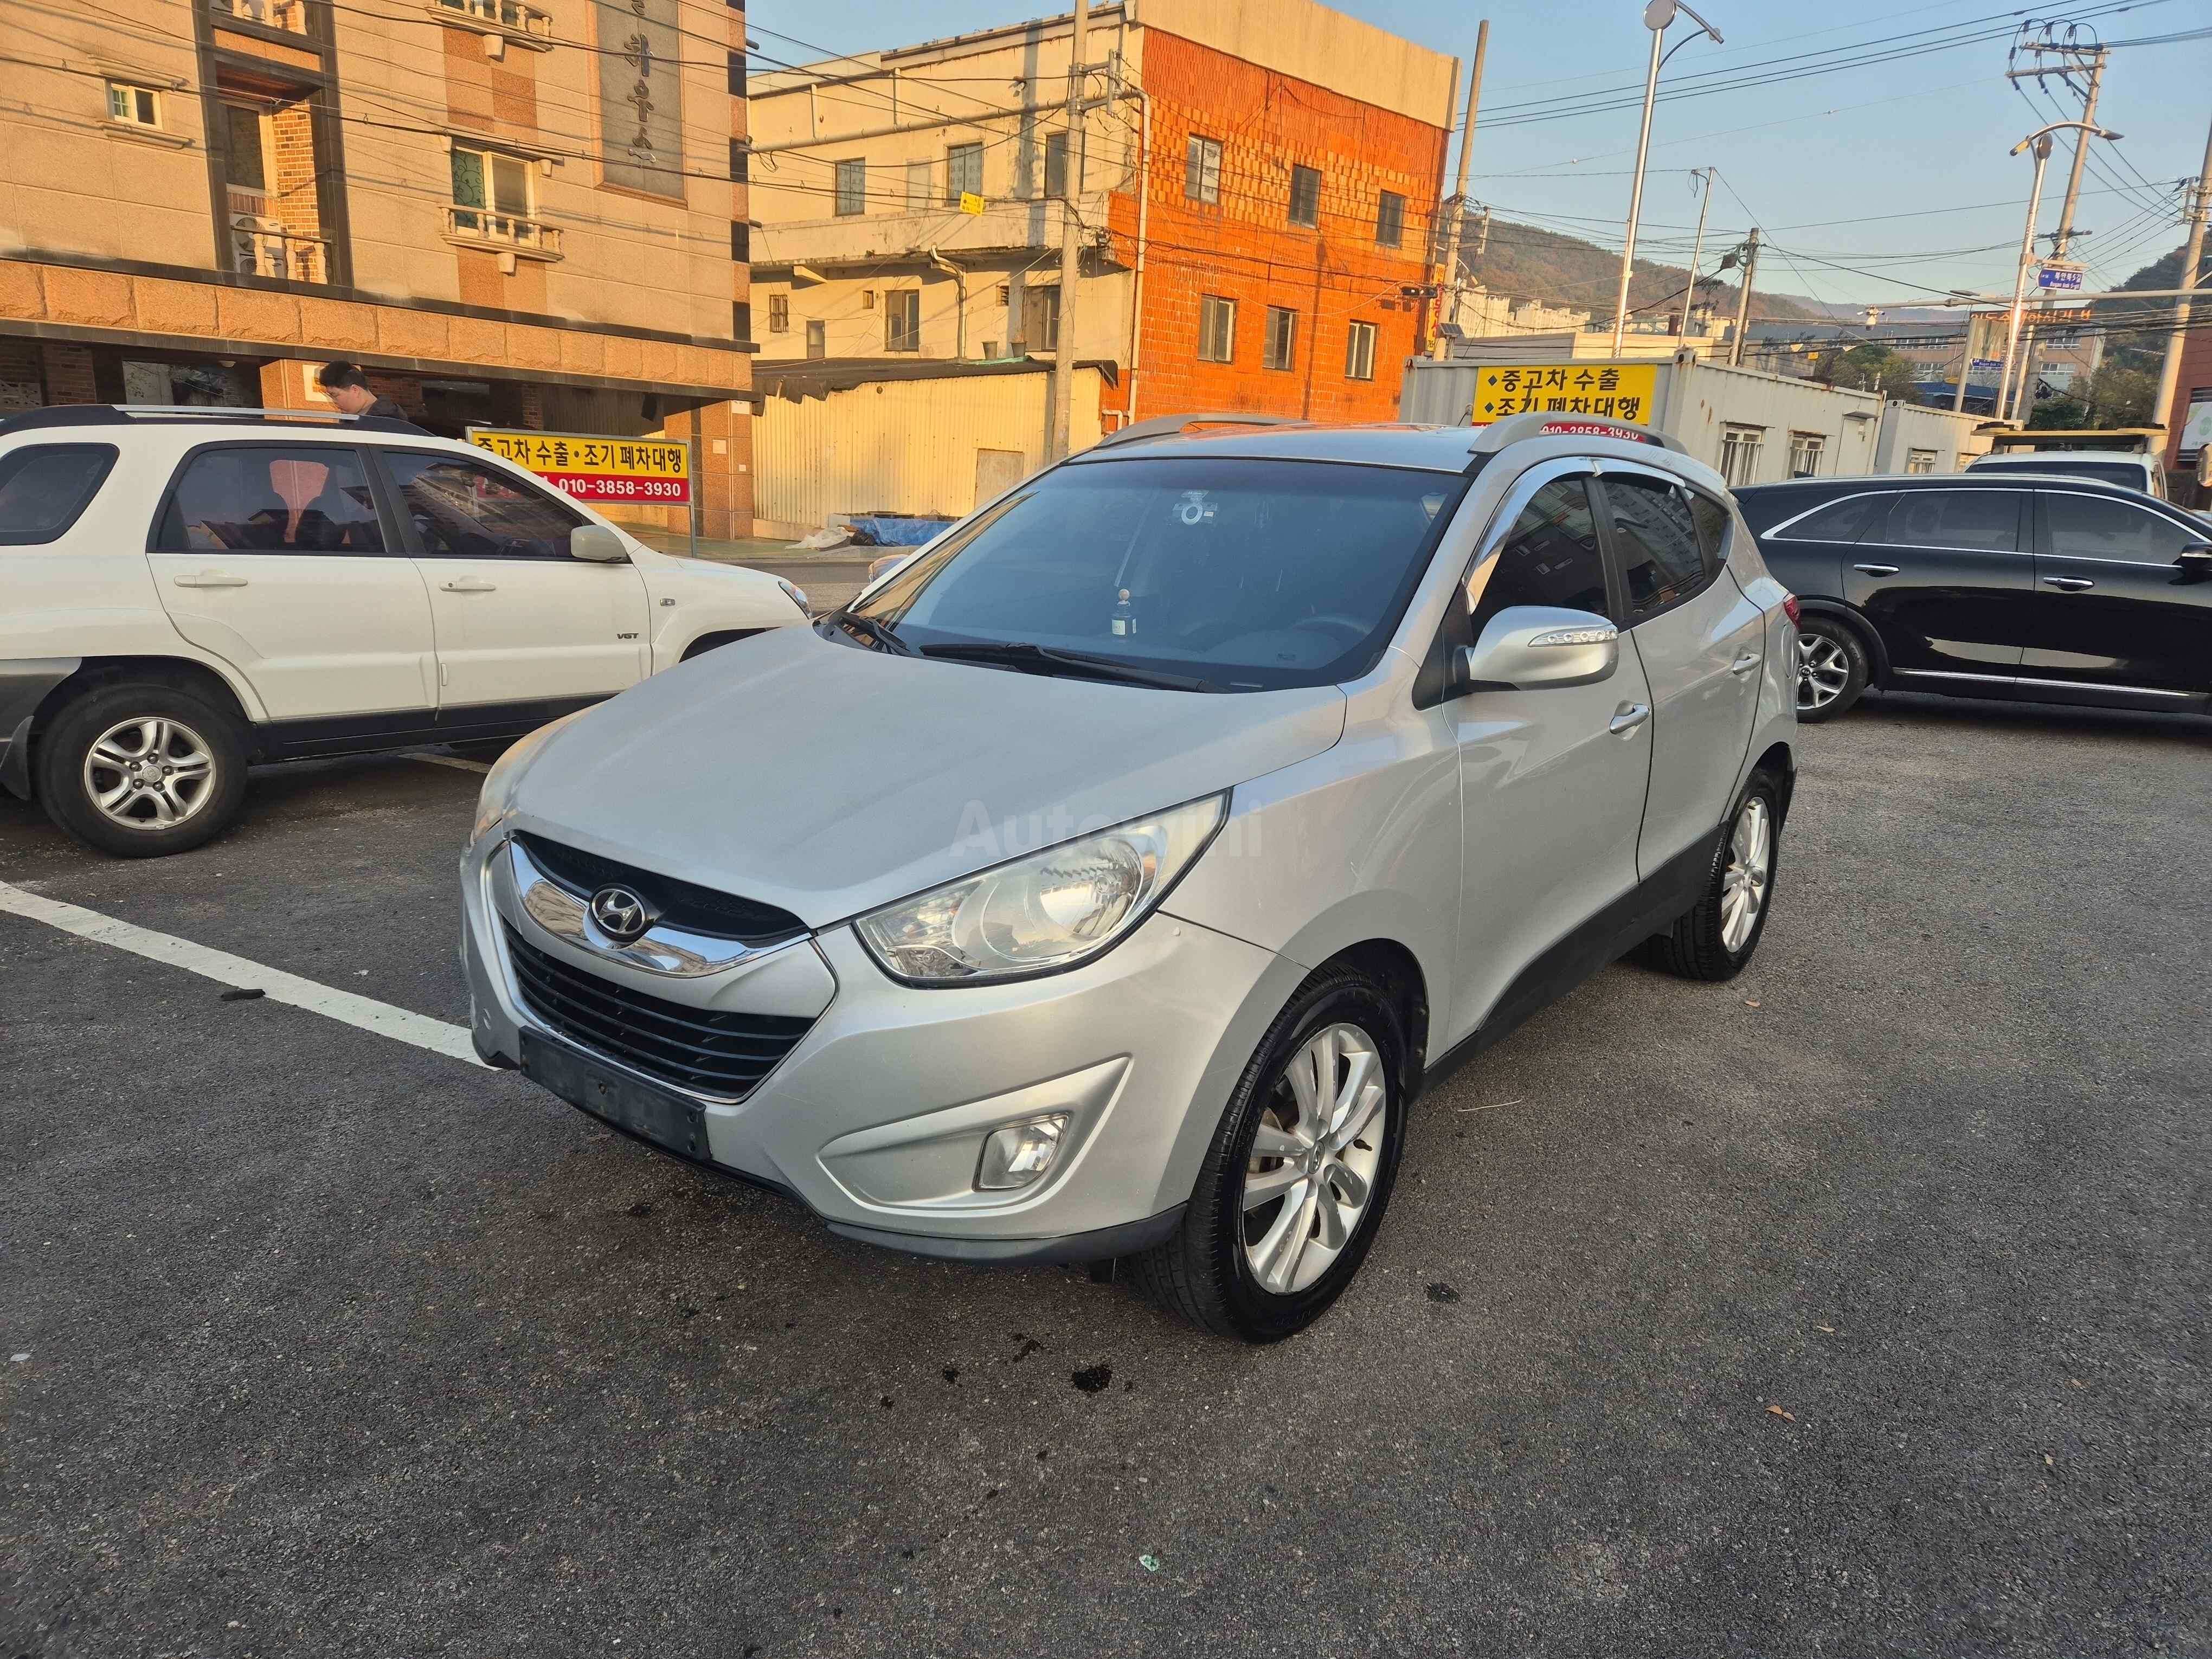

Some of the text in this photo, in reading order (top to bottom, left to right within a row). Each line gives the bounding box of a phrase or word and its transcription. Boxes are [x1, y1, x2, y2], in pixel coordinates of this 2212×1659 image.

[1501, 369, 1620, 393] 중고차 수출
[1547, 397, 1640, 421] 폐차대행
[620, 447, 681, 473] 폐차대행
[558, 477, 681, 497] 010-3858-3930
